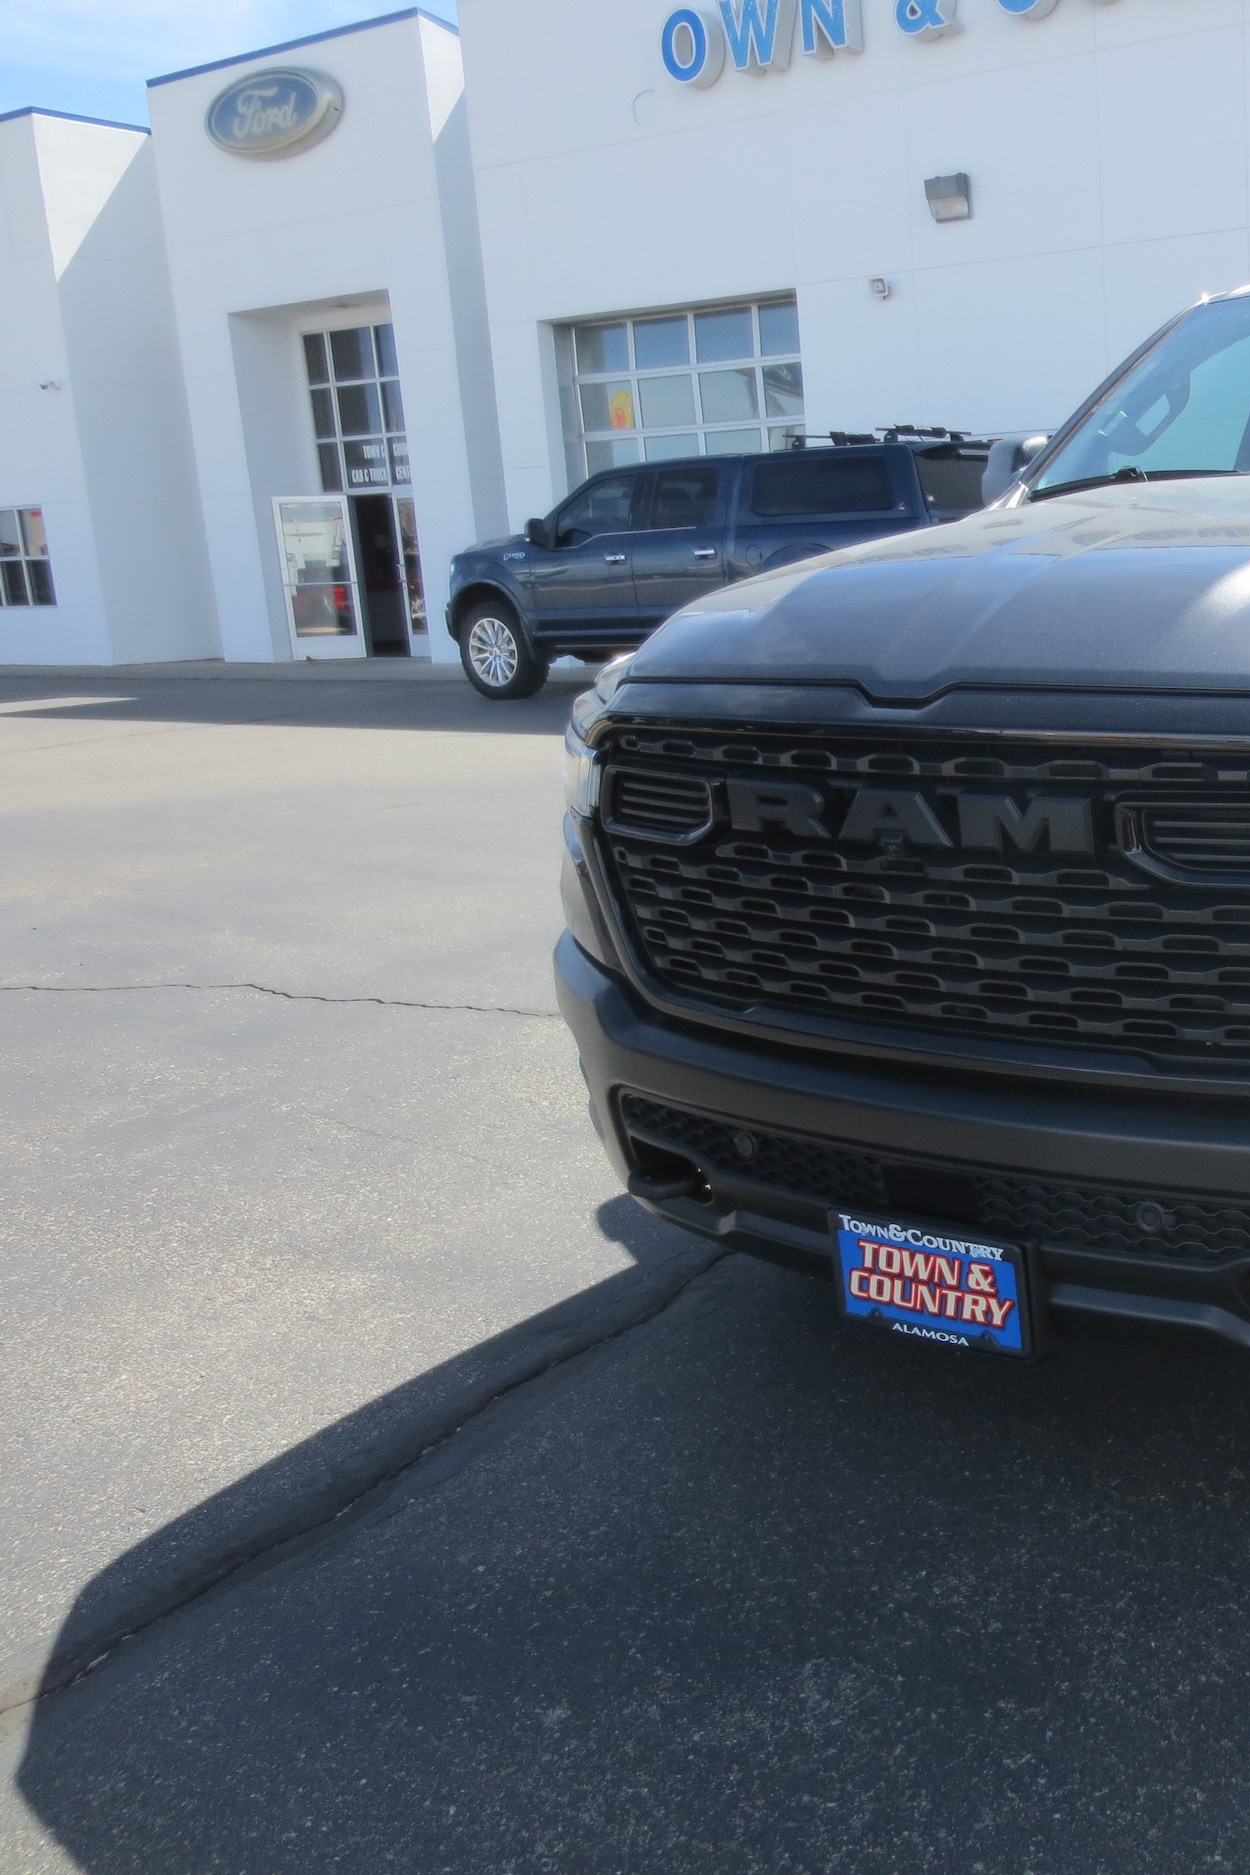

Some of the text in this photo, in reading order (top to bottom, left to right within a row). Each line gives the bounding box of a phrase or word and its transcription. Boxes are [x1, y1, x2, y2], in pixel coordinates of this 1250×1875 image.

[232, 86, 298, 140] Ford
[726, 777, 1095, 856] RAM
[857, 1239, 997, 1294] TOWN &
[849, 1269, 1014, 1329] COUNTRY
[891, 1322, 970, 1347] ALAMOSA
